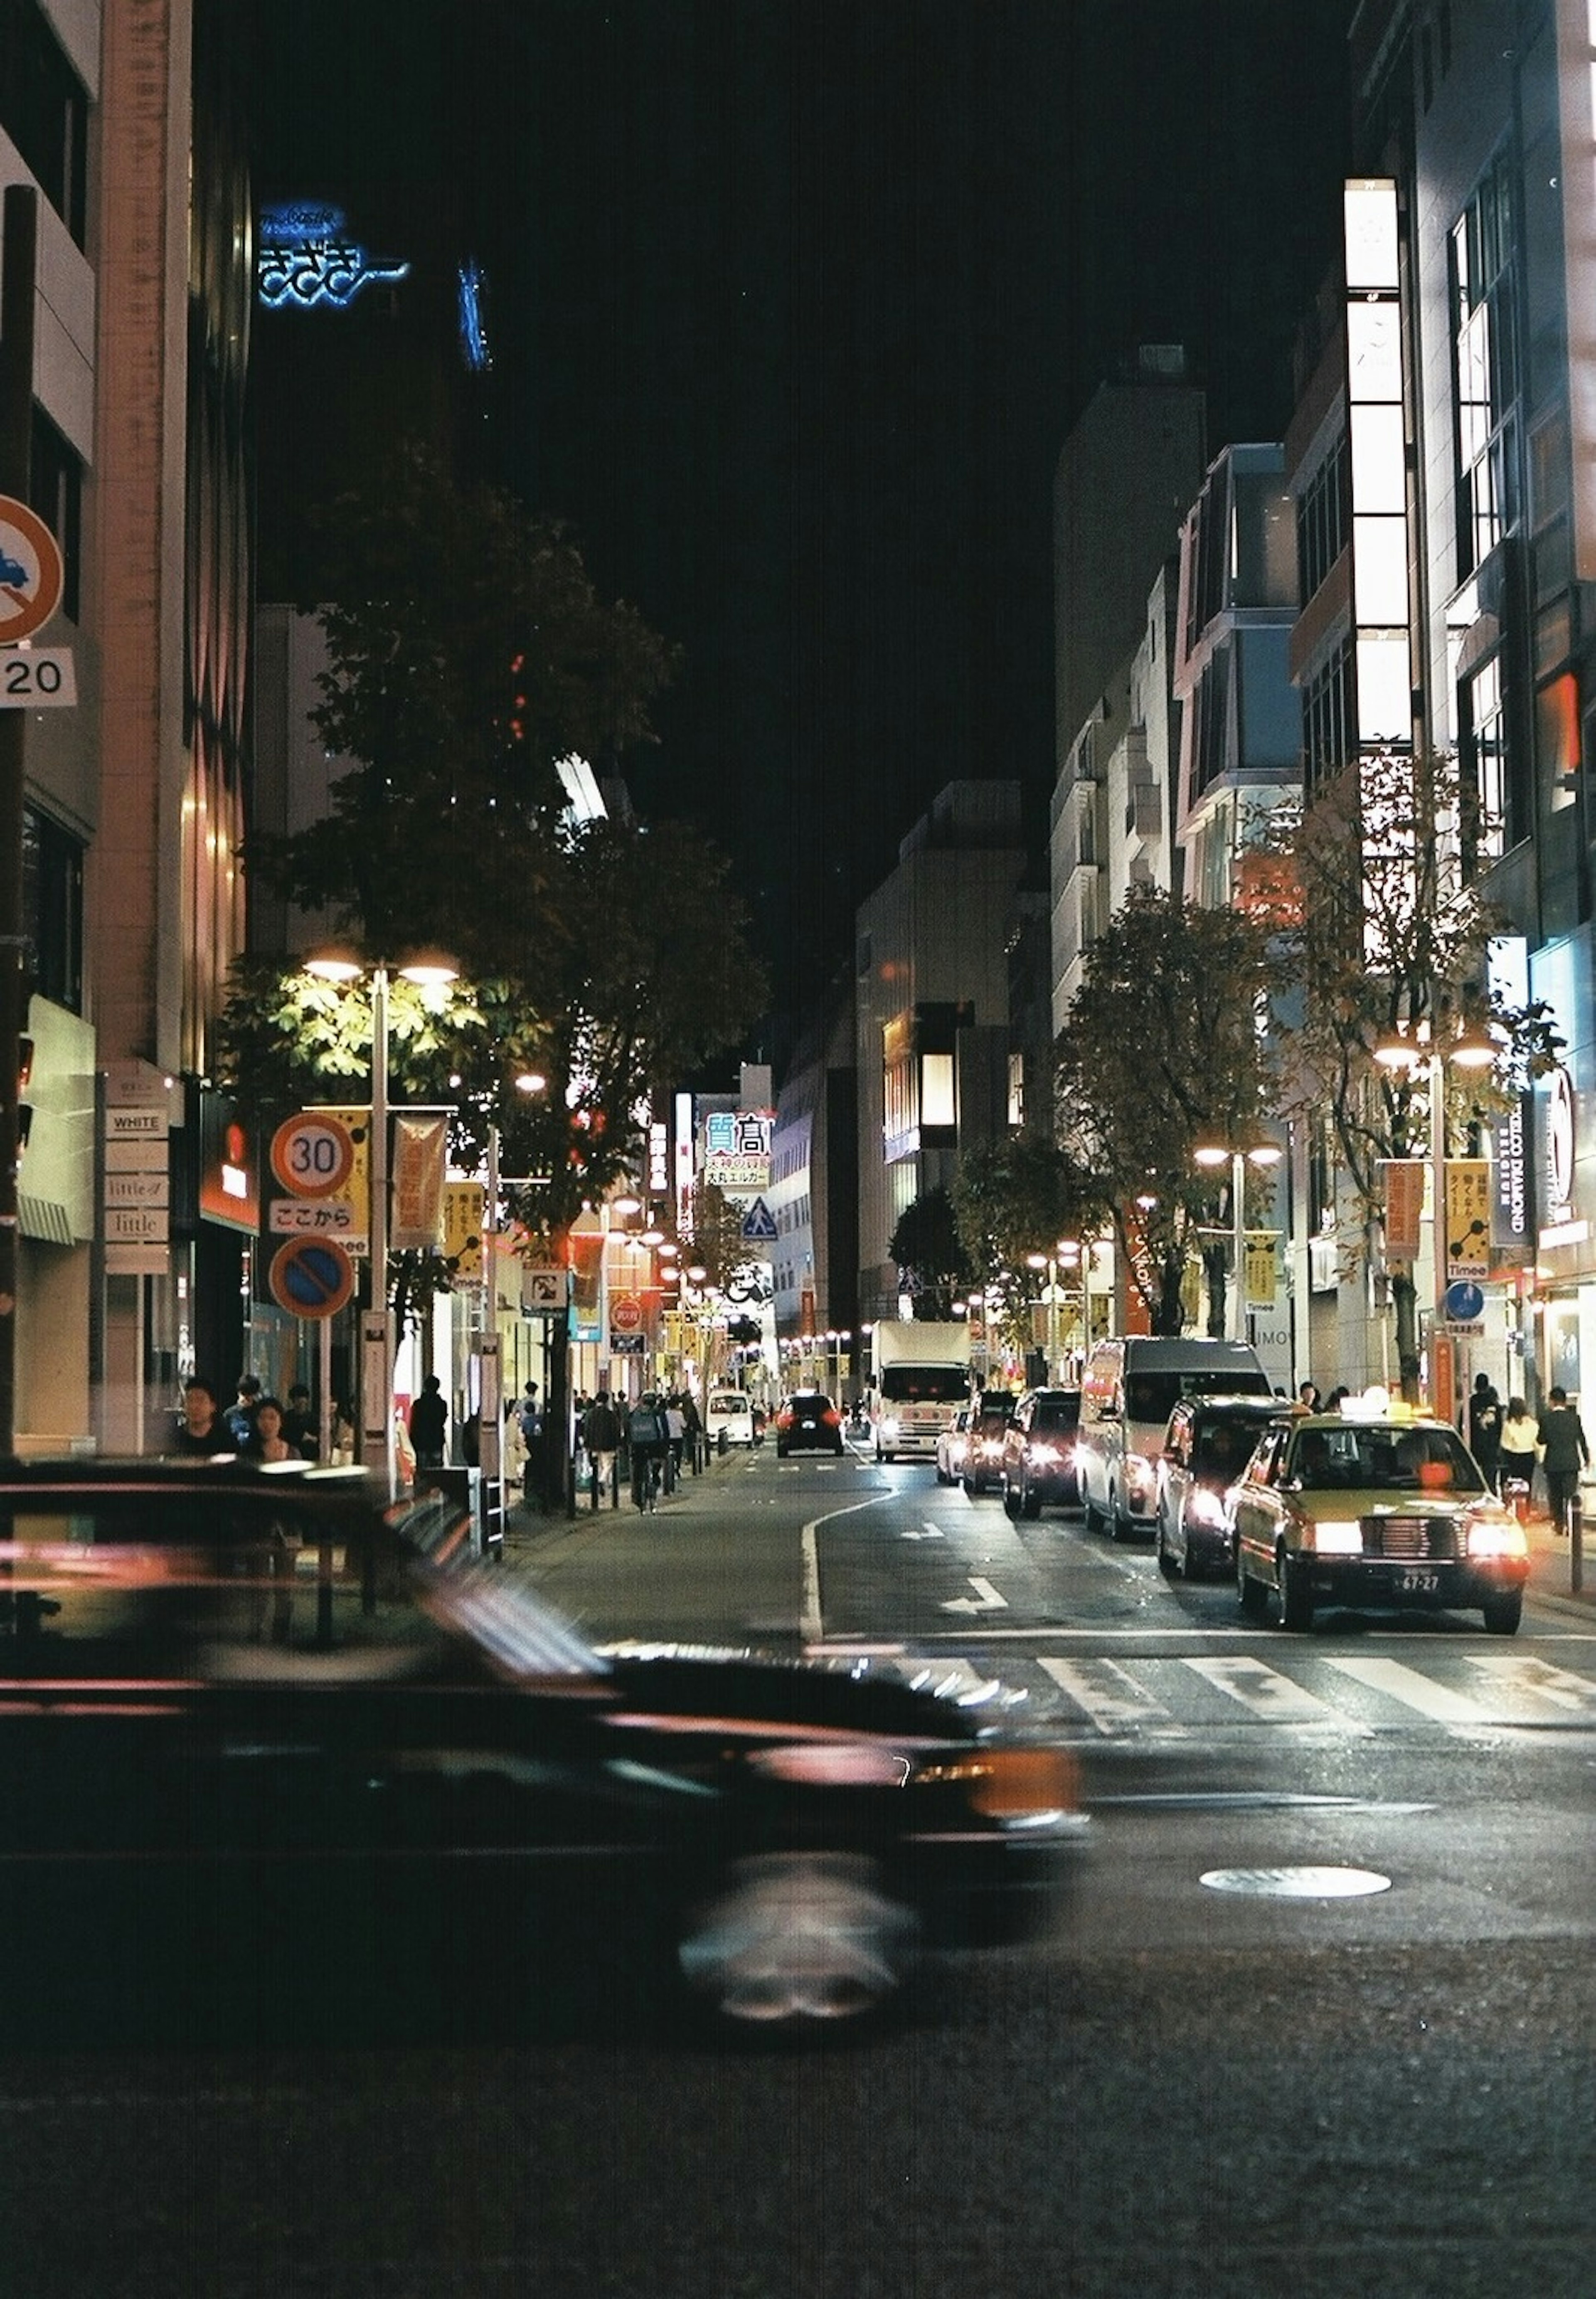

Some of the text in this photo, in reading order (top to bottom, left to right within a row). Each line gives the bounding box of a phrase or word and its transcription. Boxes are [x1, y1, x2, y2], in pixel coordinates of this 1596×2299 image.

[6, 660, 61, 693] 20
[114, 1117, 159, 1127] WHITE
[292, 1137, 335, 1173] 30
[1499, 1128, 1510, 1205] BELGIUM
[109, 1180, 145, 1196] little
[1510, 1158, 1525, 1234] DIAMOND
[116, 1214, 156, 1232] little
[276, 1208, 350, 1227] ここから
[1449, 1265, 1486, 1276] Timee
